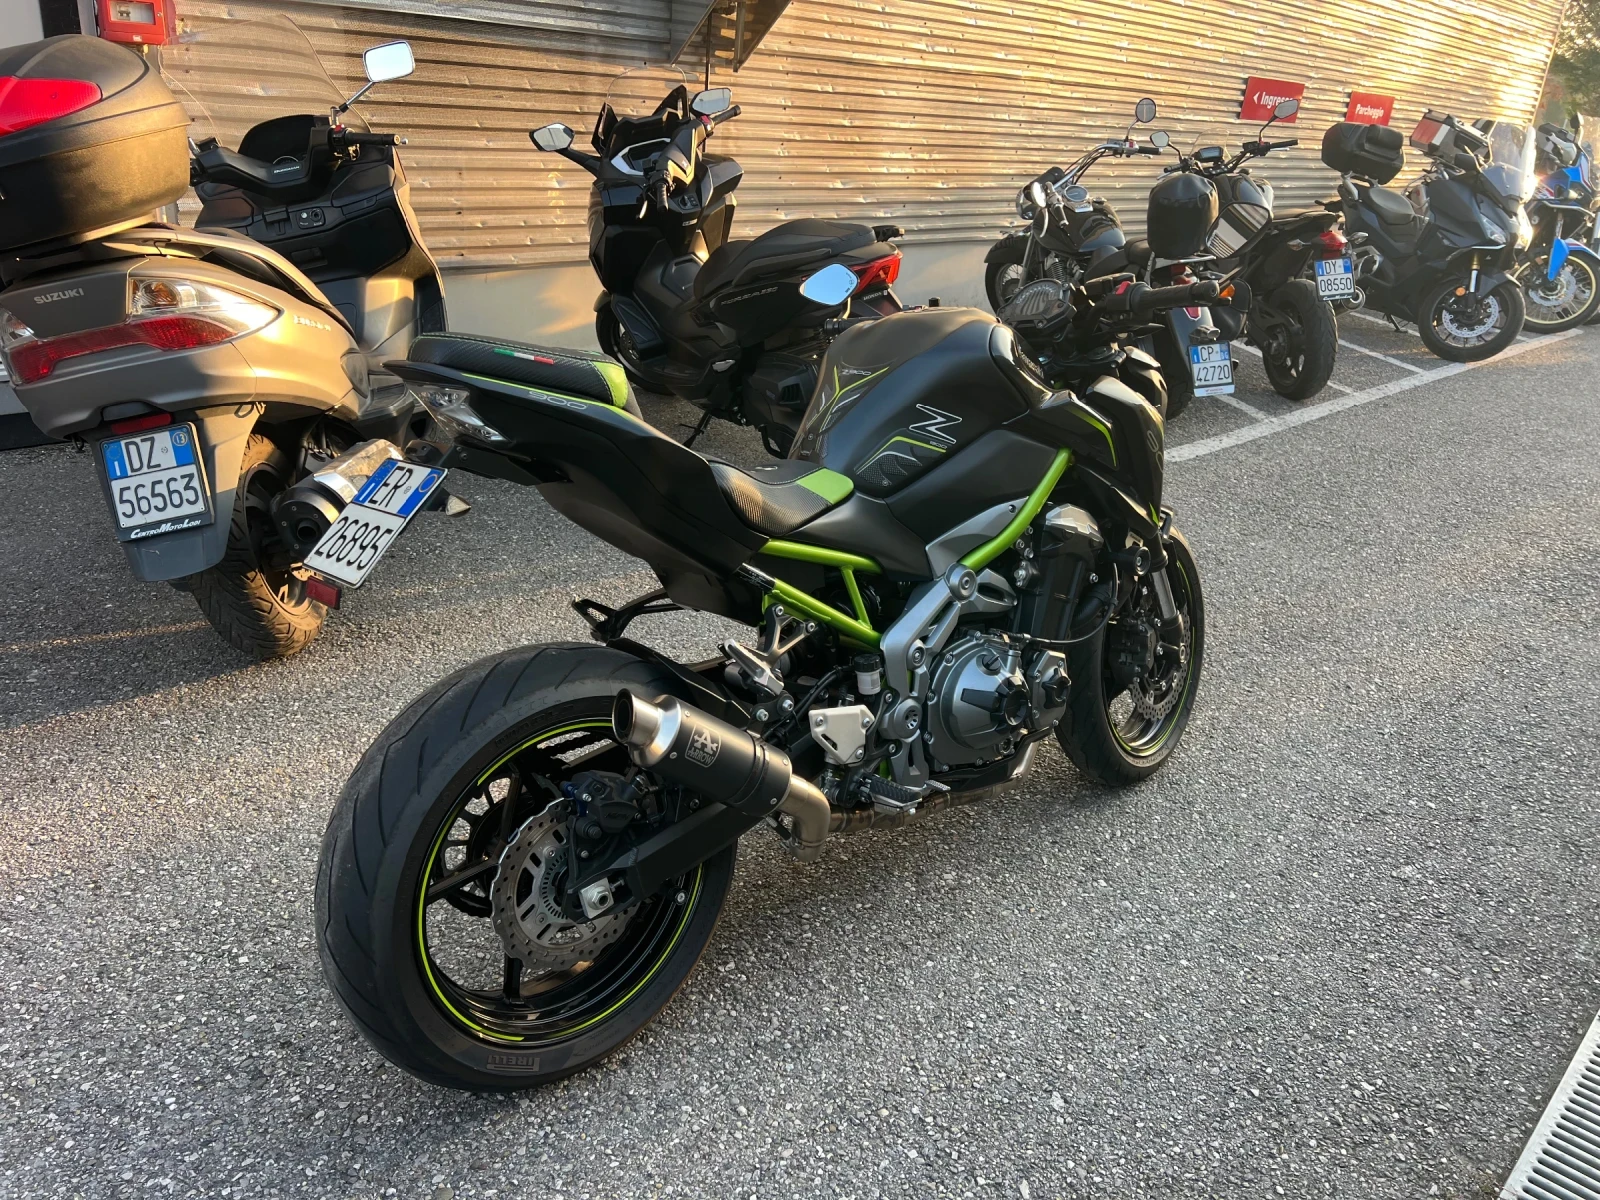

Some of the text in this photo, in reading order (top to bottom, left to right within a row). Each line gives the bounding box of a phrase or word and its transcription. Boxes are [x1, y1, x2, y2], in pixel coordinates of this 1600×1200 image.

[1355, 103, 1385, 119] Parcheggio
[1324, 260, 1337, 275] DY
[1320, 277, 1352, 292] 08550
[33, 287, 85, 304] SUZUKI
[1200, 346, 1214, 361] CP
[1196, 364, 1230, 382] 42720
[528, 390, 588, 410] 900
[124, 436, 162, 474] DZ
[174, 434, 186, 444] 13
[118, 472, 200, 519] 56563
[367, 465, 414, 509] ER
[313, 515, 395, 571] 26895
[687, 746, 715, 765] ARROW
[486, 1054, 541, 1072] PIRELLI
